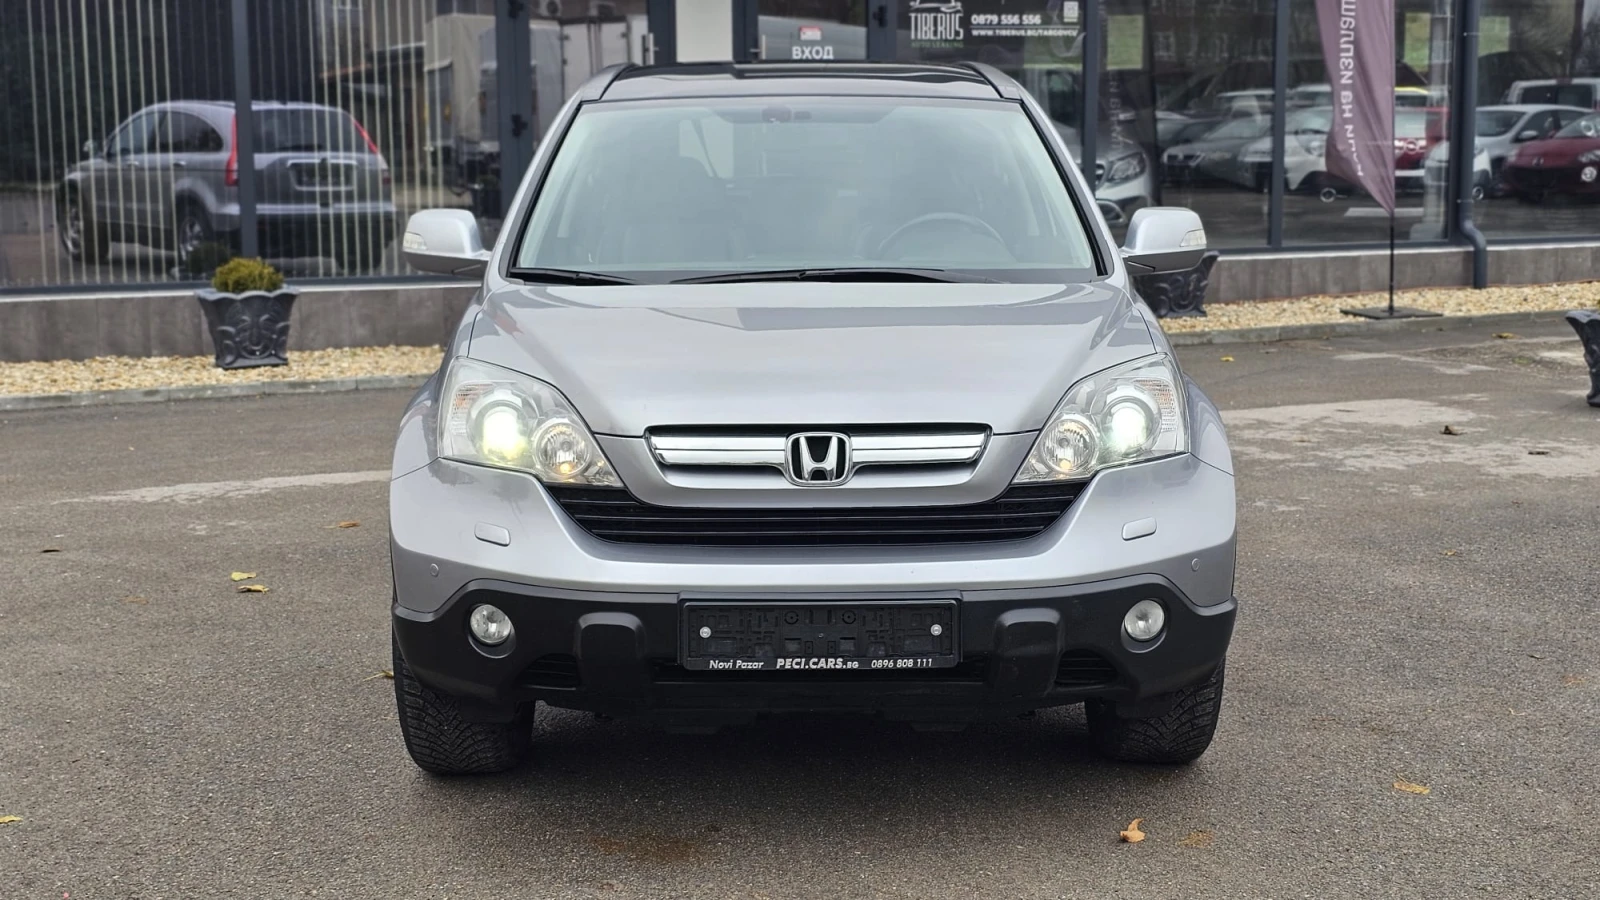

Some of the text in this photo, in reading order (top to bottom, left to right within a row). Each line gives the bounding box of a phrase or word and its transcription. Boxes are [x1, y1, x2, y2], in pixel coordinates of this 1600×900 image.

[971, 14, 1042, 25] 0879 556 556
[908, 13, 964, 40] TIBERUS
[792, 46, 834, 60] ВХОД
[709, 660, 733, 669] Novi
[735, 660, 764, 669] Pazar
[871, 659, 894, 668] 0896
[896, 659, 914, 668] 808
[917, 658, 933, 668] 111
